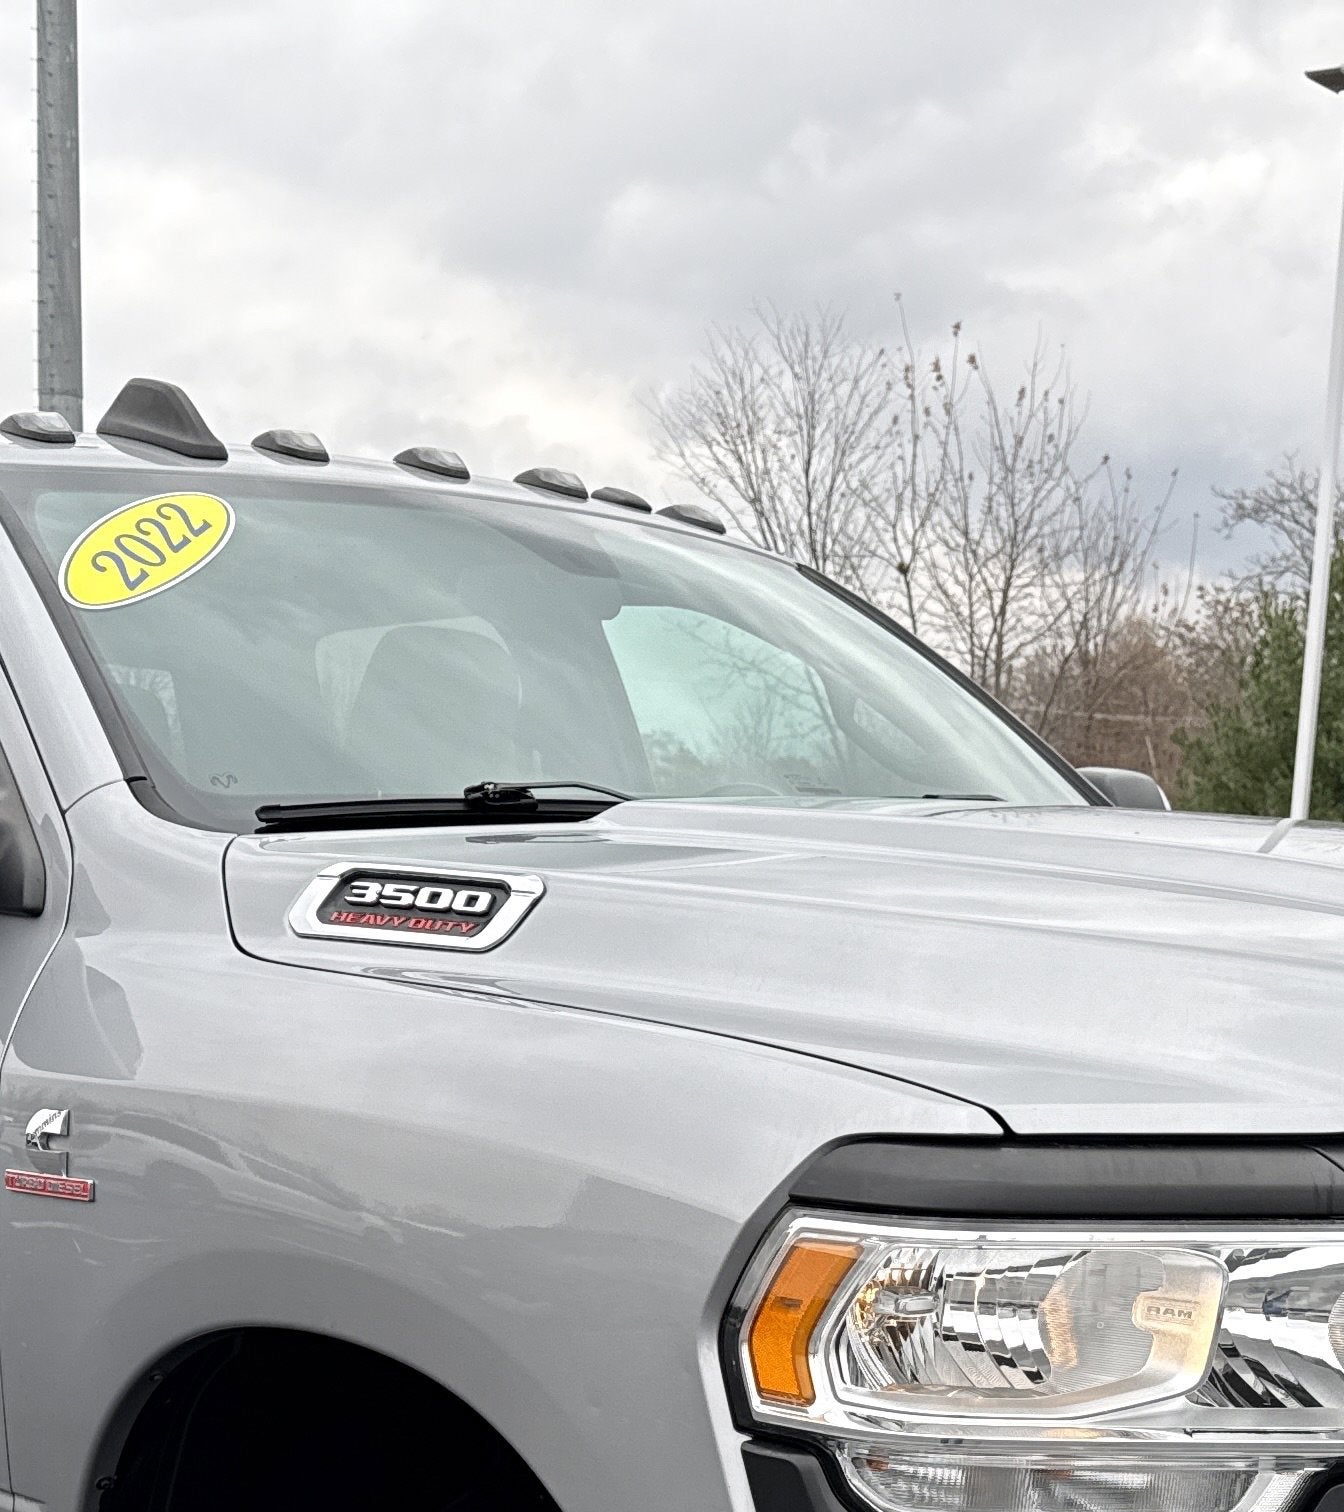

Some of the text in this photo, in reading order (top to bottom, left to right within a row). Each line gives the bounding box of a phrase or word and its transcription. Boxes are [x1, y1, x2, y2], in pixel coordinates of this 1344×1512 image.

[90, 502, 213, 592] 2022
[343, 880, 497, 917] 3500
[329, 911, 479, 938] HEAVY DUTY
[1146, 1305, 1193, 1319] RAM
